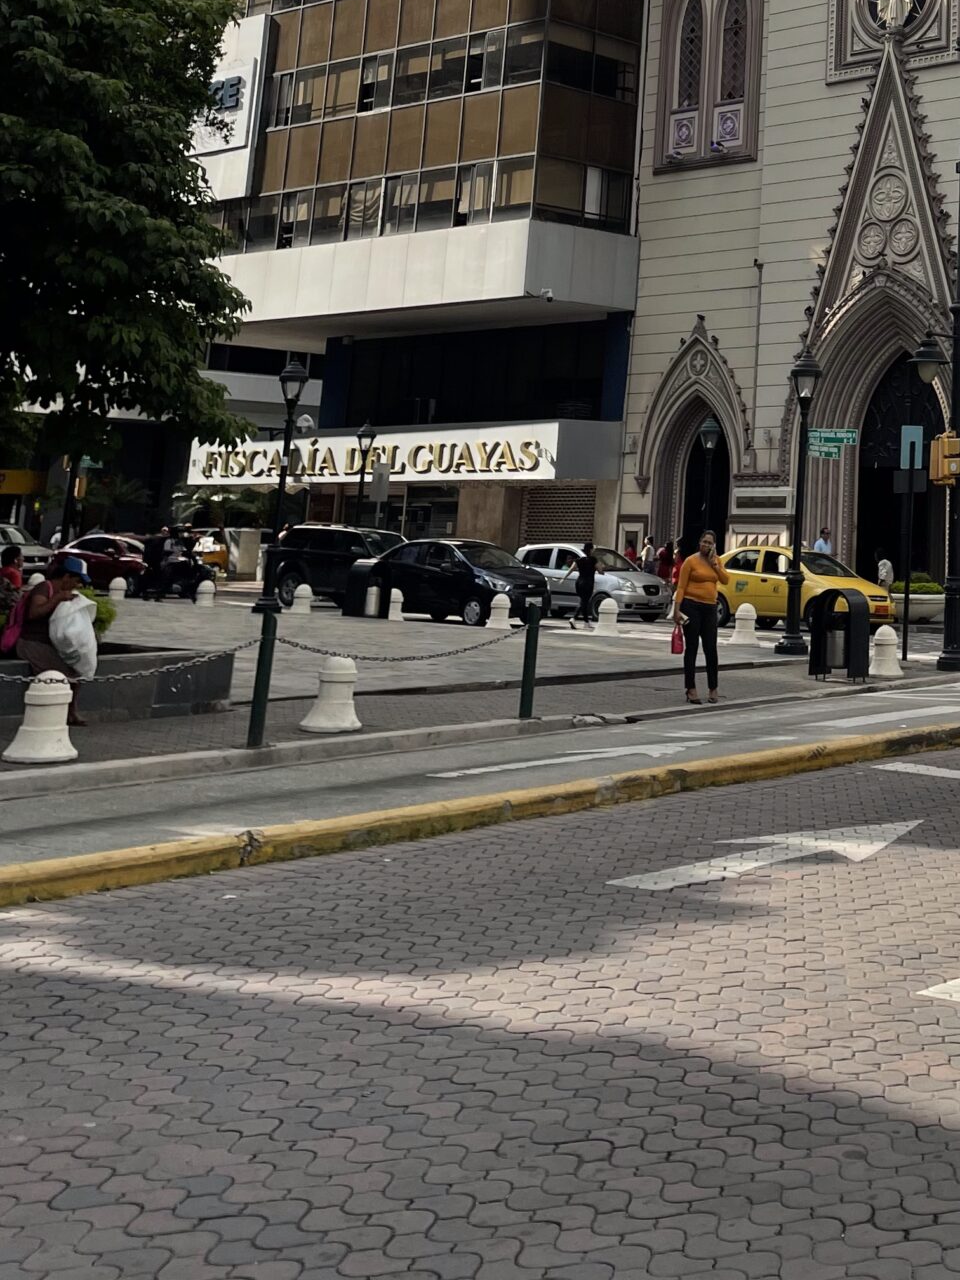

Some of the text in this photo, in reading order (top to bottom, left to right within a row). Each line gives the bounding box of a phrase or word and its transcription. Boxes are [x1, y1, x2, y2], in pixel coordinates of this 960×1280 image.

[202, 437, 540, 479] FISCALÍA DEL GUAYAS
